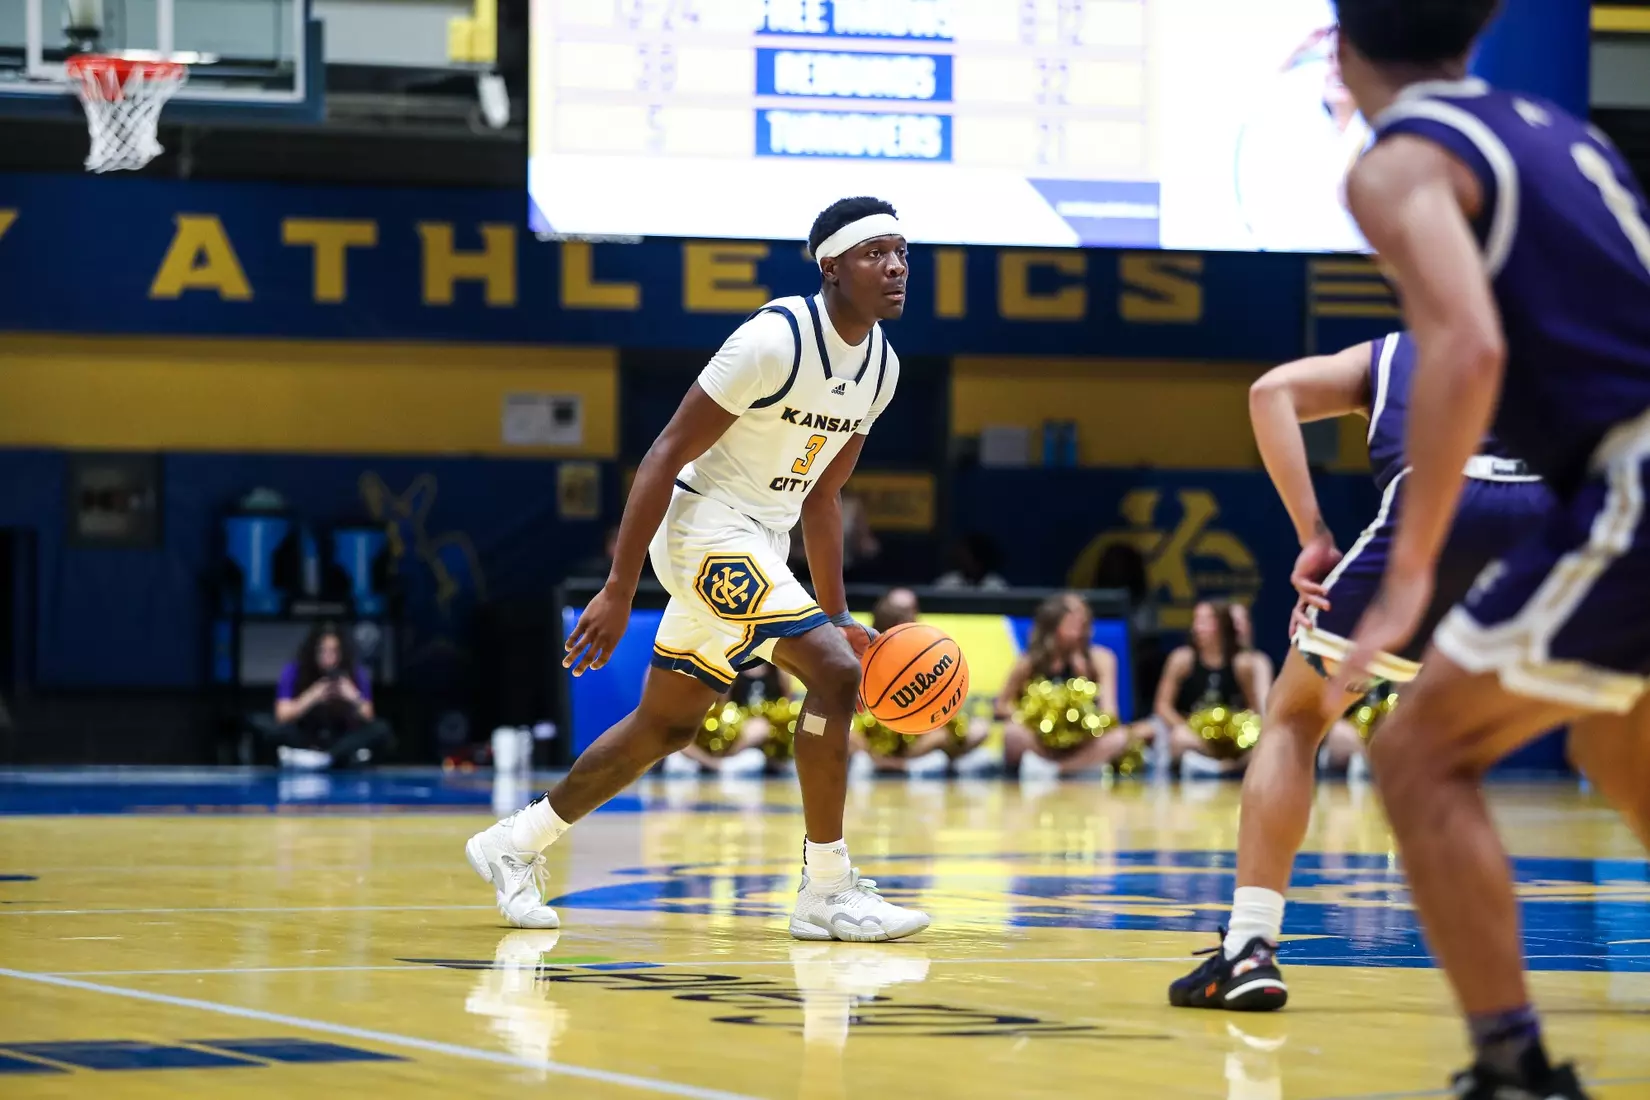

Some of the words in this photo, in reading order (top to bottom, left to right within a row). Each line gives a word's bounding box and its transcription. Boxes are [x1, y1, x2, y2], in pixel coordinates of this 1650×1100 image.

[148, 212, 1204, 324] ATHLEICS
[780, 406, 863, 433] KANSAS
[790, 433, 828, 476] 3
[768, 476, 813, 493] CITY
[890, 653, 954, 709] Wilson
